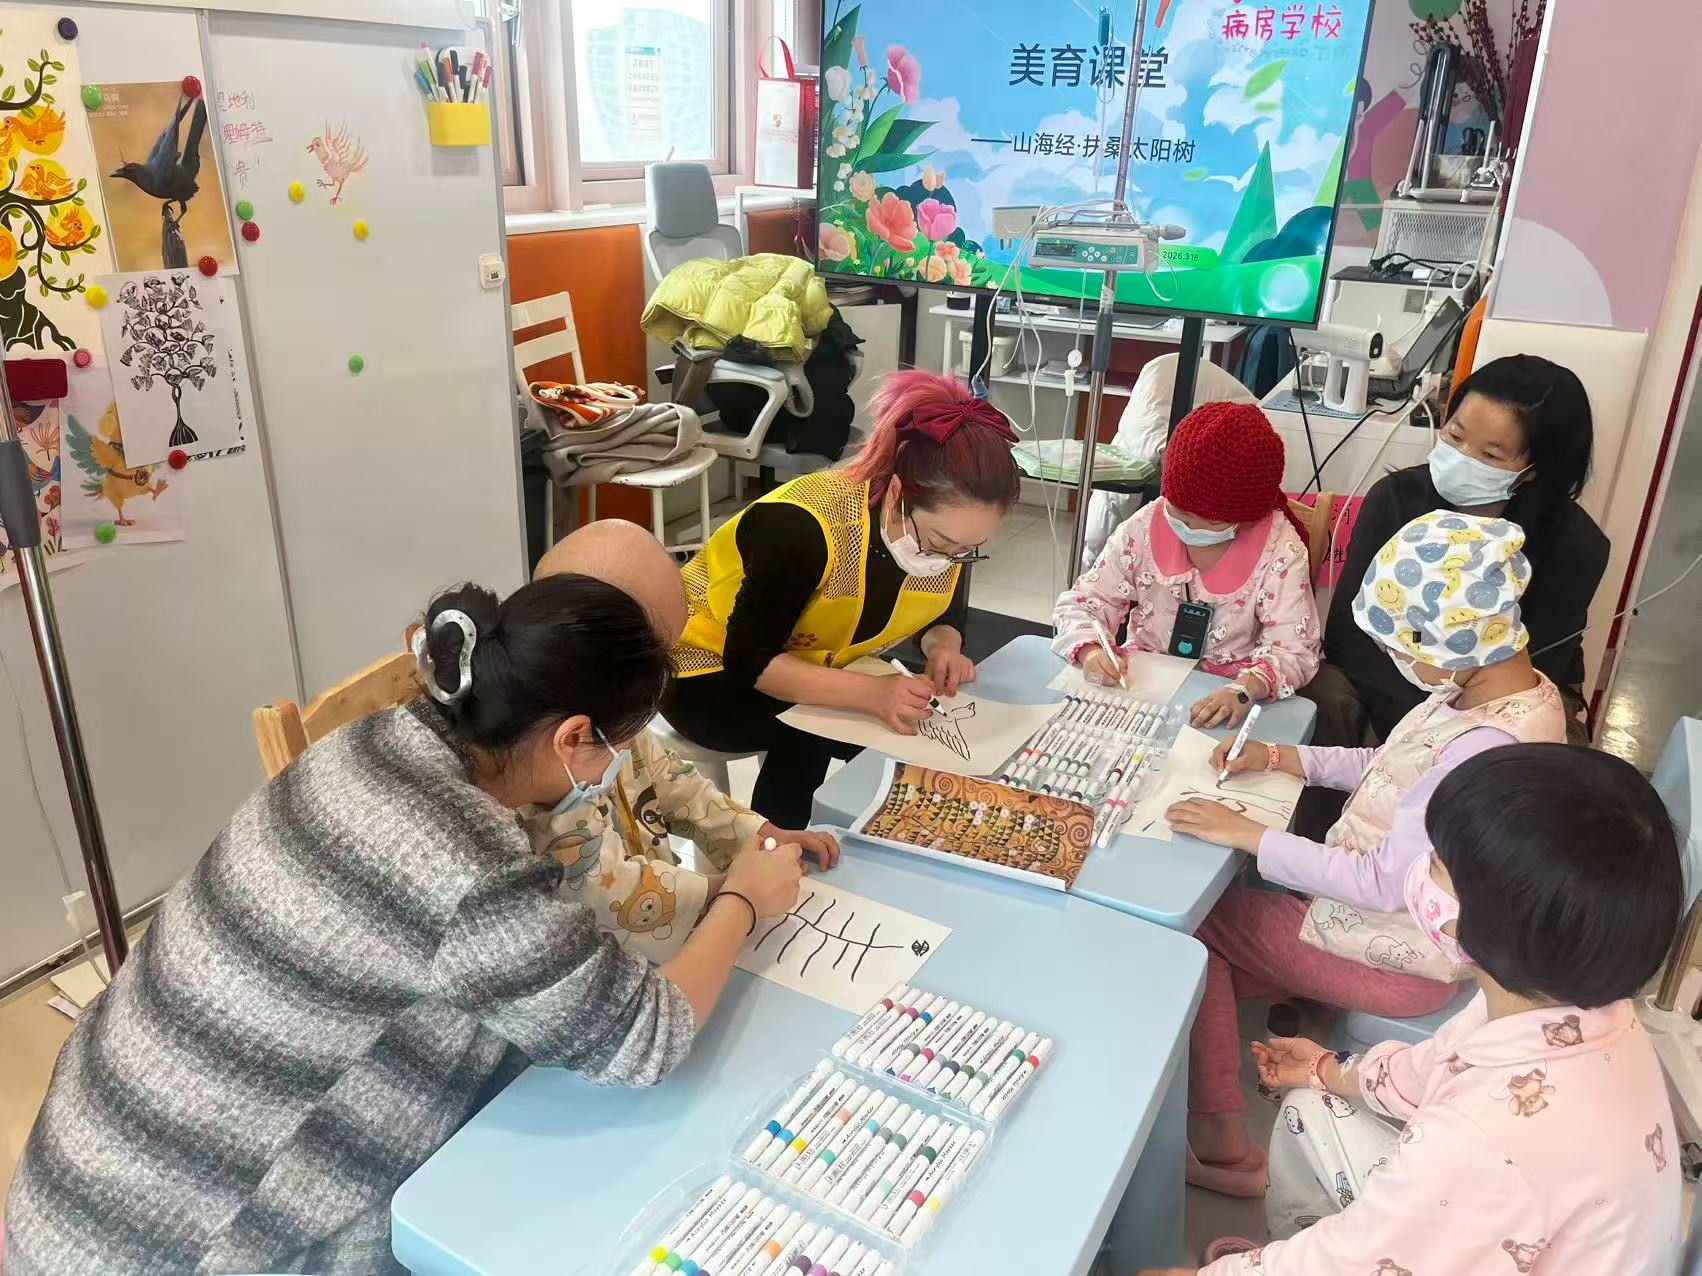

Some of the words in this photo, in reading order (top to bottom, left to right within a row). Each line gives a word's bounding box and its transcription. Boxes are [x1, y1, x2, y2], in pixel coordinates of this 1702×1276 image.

[1222, 4, 1342, 41] 病房学校
[1009, 43, 1169, 89] 美育课堂
[927, 1157, 944, 1177] Acrylic
[940, 1139, 957, 1158] Marker
[689, 1216, 709, 1238] Acrylic
[708, 1197, 727, 1217] Marker
